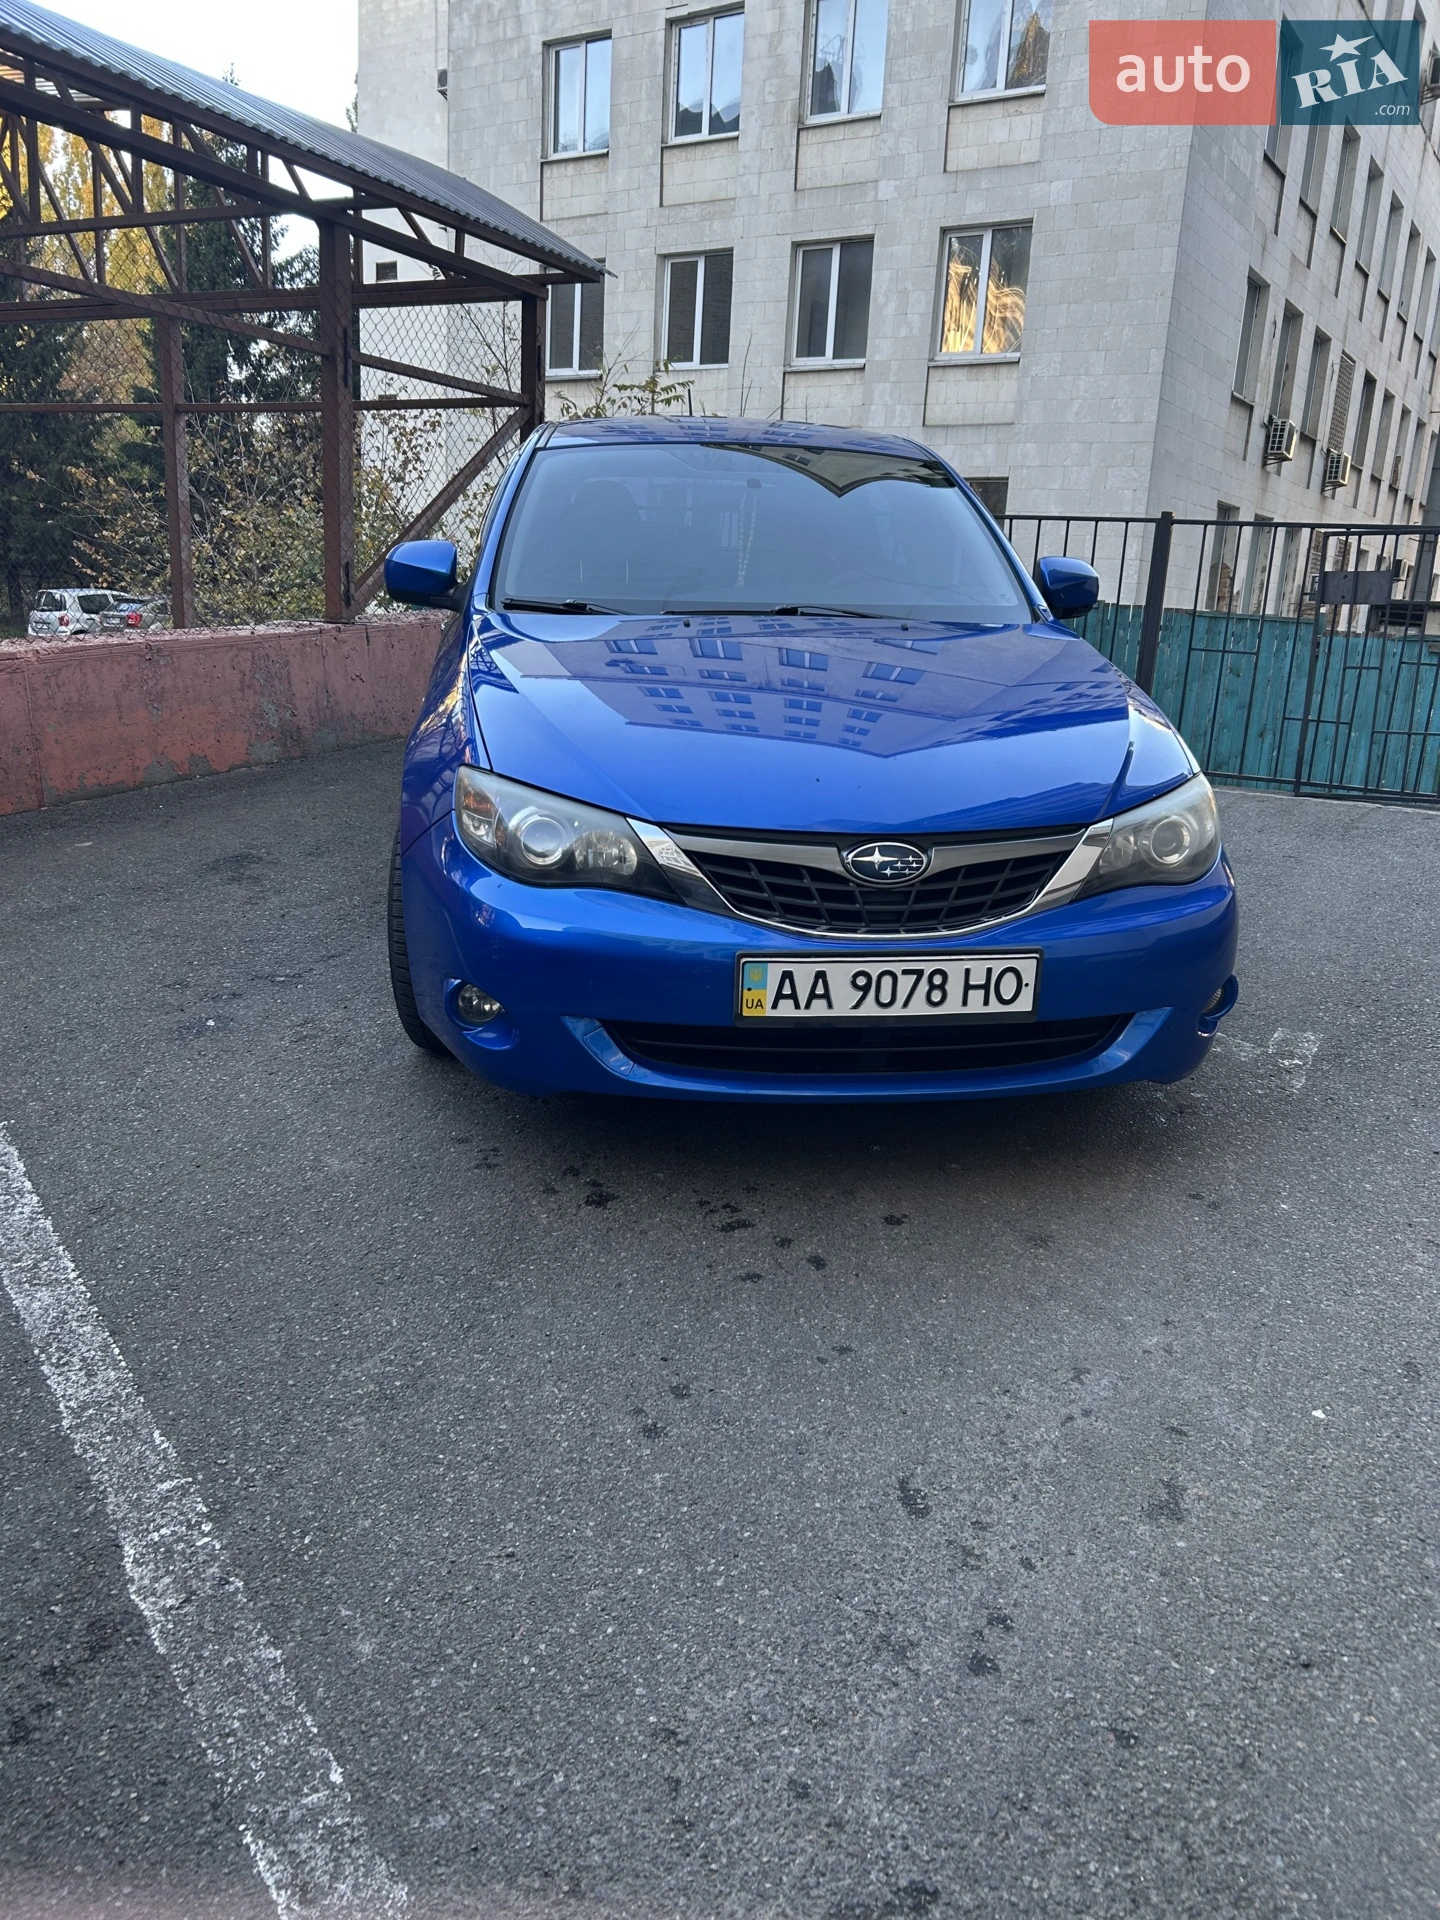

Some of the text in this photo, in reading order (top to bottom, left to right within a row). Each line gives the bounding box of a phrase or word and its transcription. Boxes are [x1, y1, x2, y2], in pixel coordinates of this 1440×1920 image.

[770, 965, 1023, 1010] AA 9078 HO
[745, 998, 764, 1010] UA
